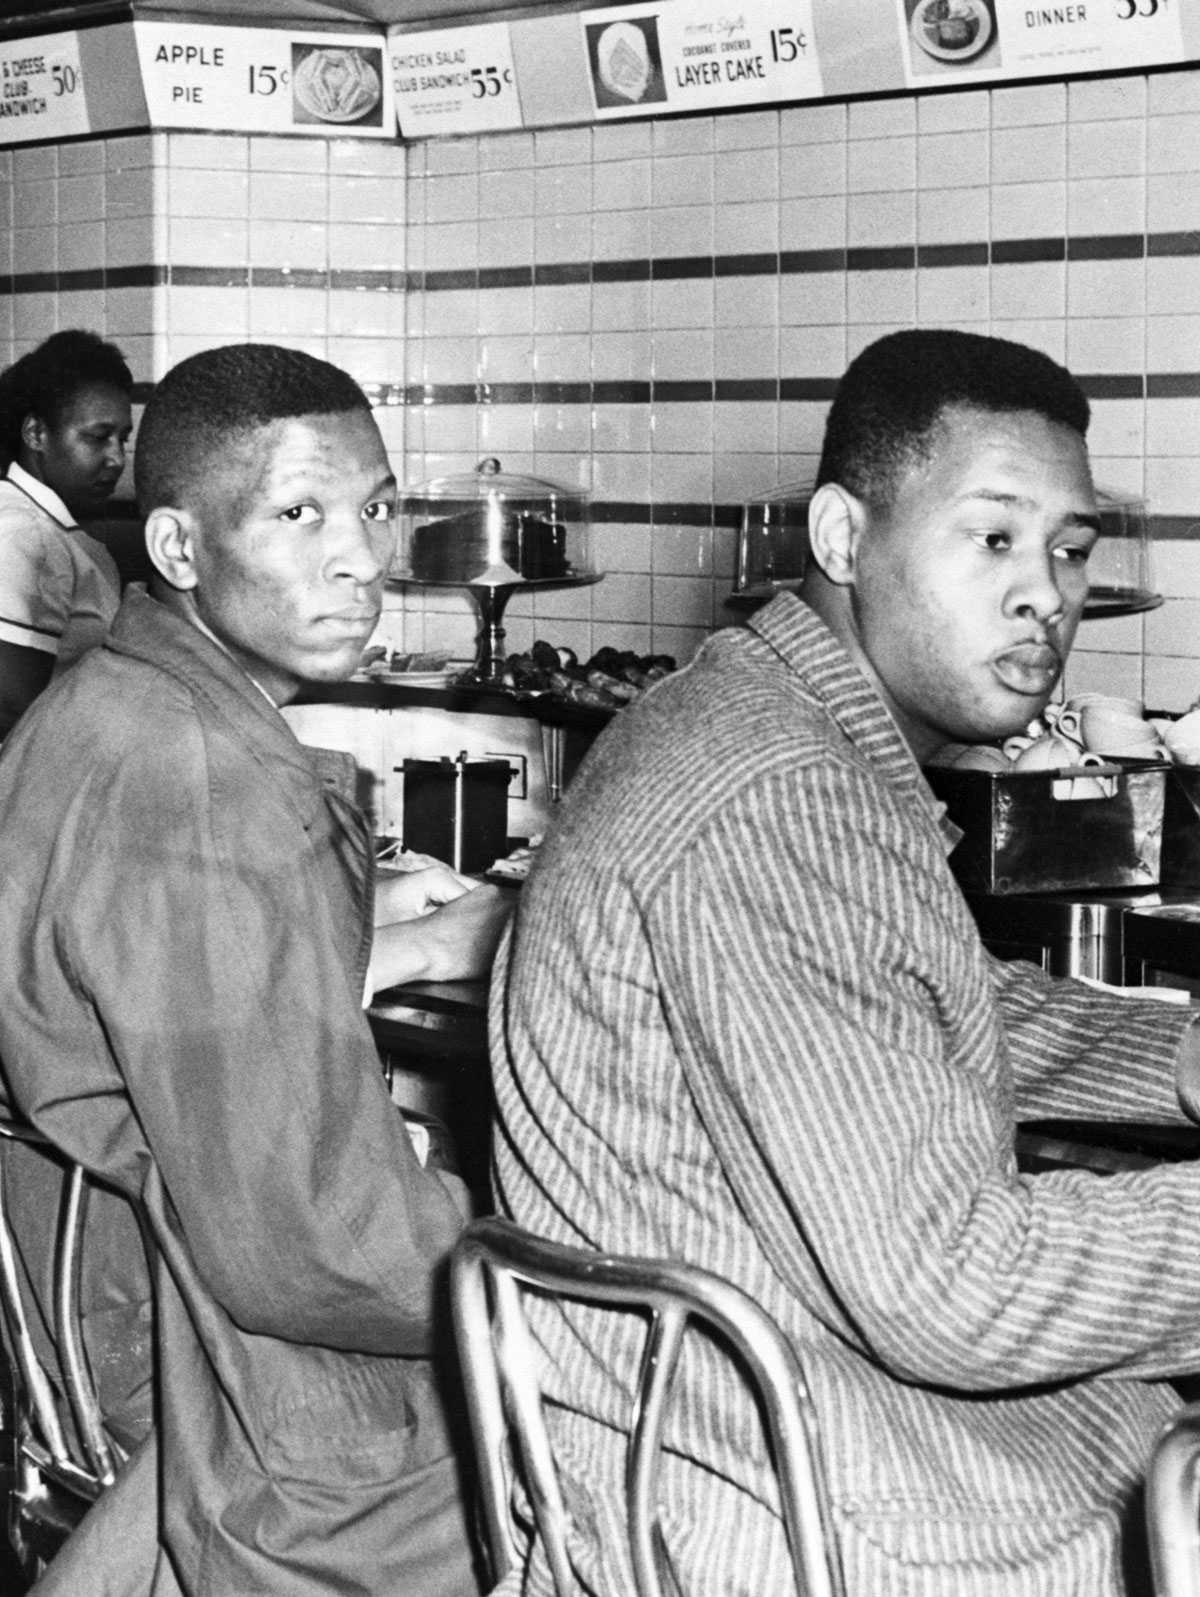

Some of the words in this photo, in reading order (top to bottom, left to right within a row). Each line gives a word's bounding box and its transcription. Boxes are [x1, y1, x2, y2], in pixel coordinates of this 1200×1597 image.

[1024, 4, 1088, 28] DINNER
[154, 44, 225, 67] APPLE
[721, 39, 752, 53] COVERED
[770, 27, 808, 63] 15¢
[11, 56, 46, 77] CHEESE
[392, 52, 433, 71] CHICKEN
[435, 48, 467, 66] SALAD
[248, 63, 290, 97] 15¢
[393, 76, 418, 94] CLUB
[419, 71, 470, 91] SANDWICH
[471, 65, 513, 99] 55¢
[675, 61, 722, 88] LAYER
[725, 56, 766, 82] CAKE
[3, 80, 28, 99] CLUB
[172, 86, 204, 104] PIE
